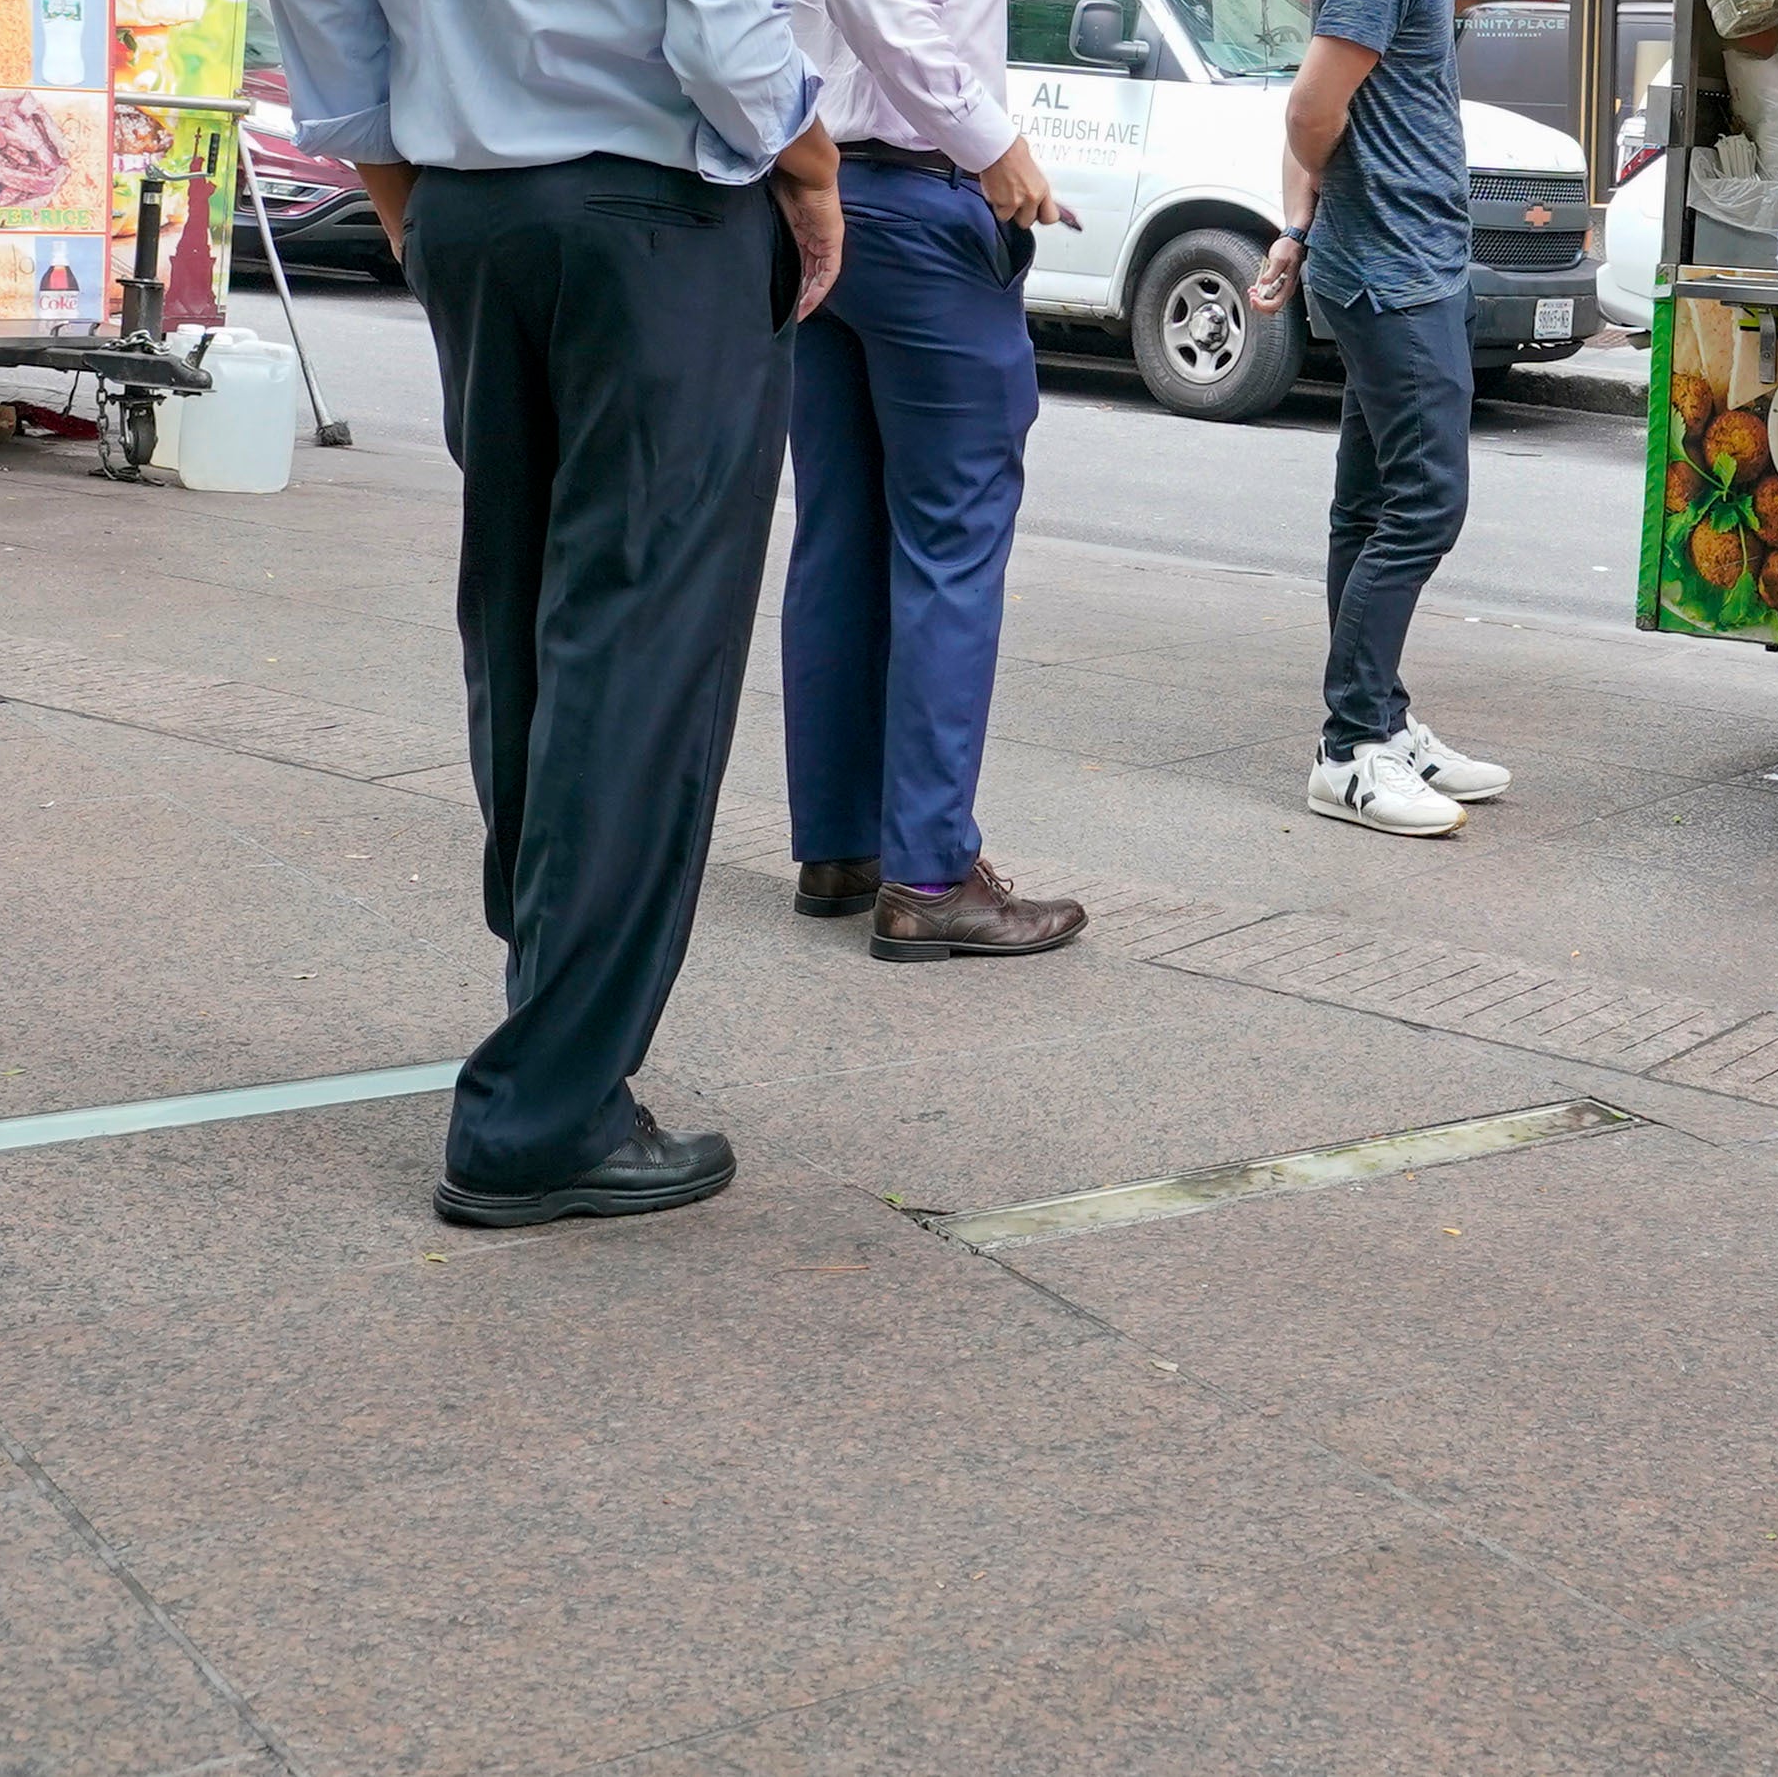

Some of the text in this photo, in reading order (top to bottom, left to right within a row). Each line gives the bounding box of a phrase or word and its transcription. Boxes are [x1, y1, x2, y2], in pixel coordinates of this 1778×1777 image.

[1454, 18, 1566, 30] TRINITY PLACE
[1031, 82, 1070, 110] AL
[1104, 122, 1140, 146] AVE
[39, 208, 91, 226] RICE
[38, 294, 78, 312] Coke
